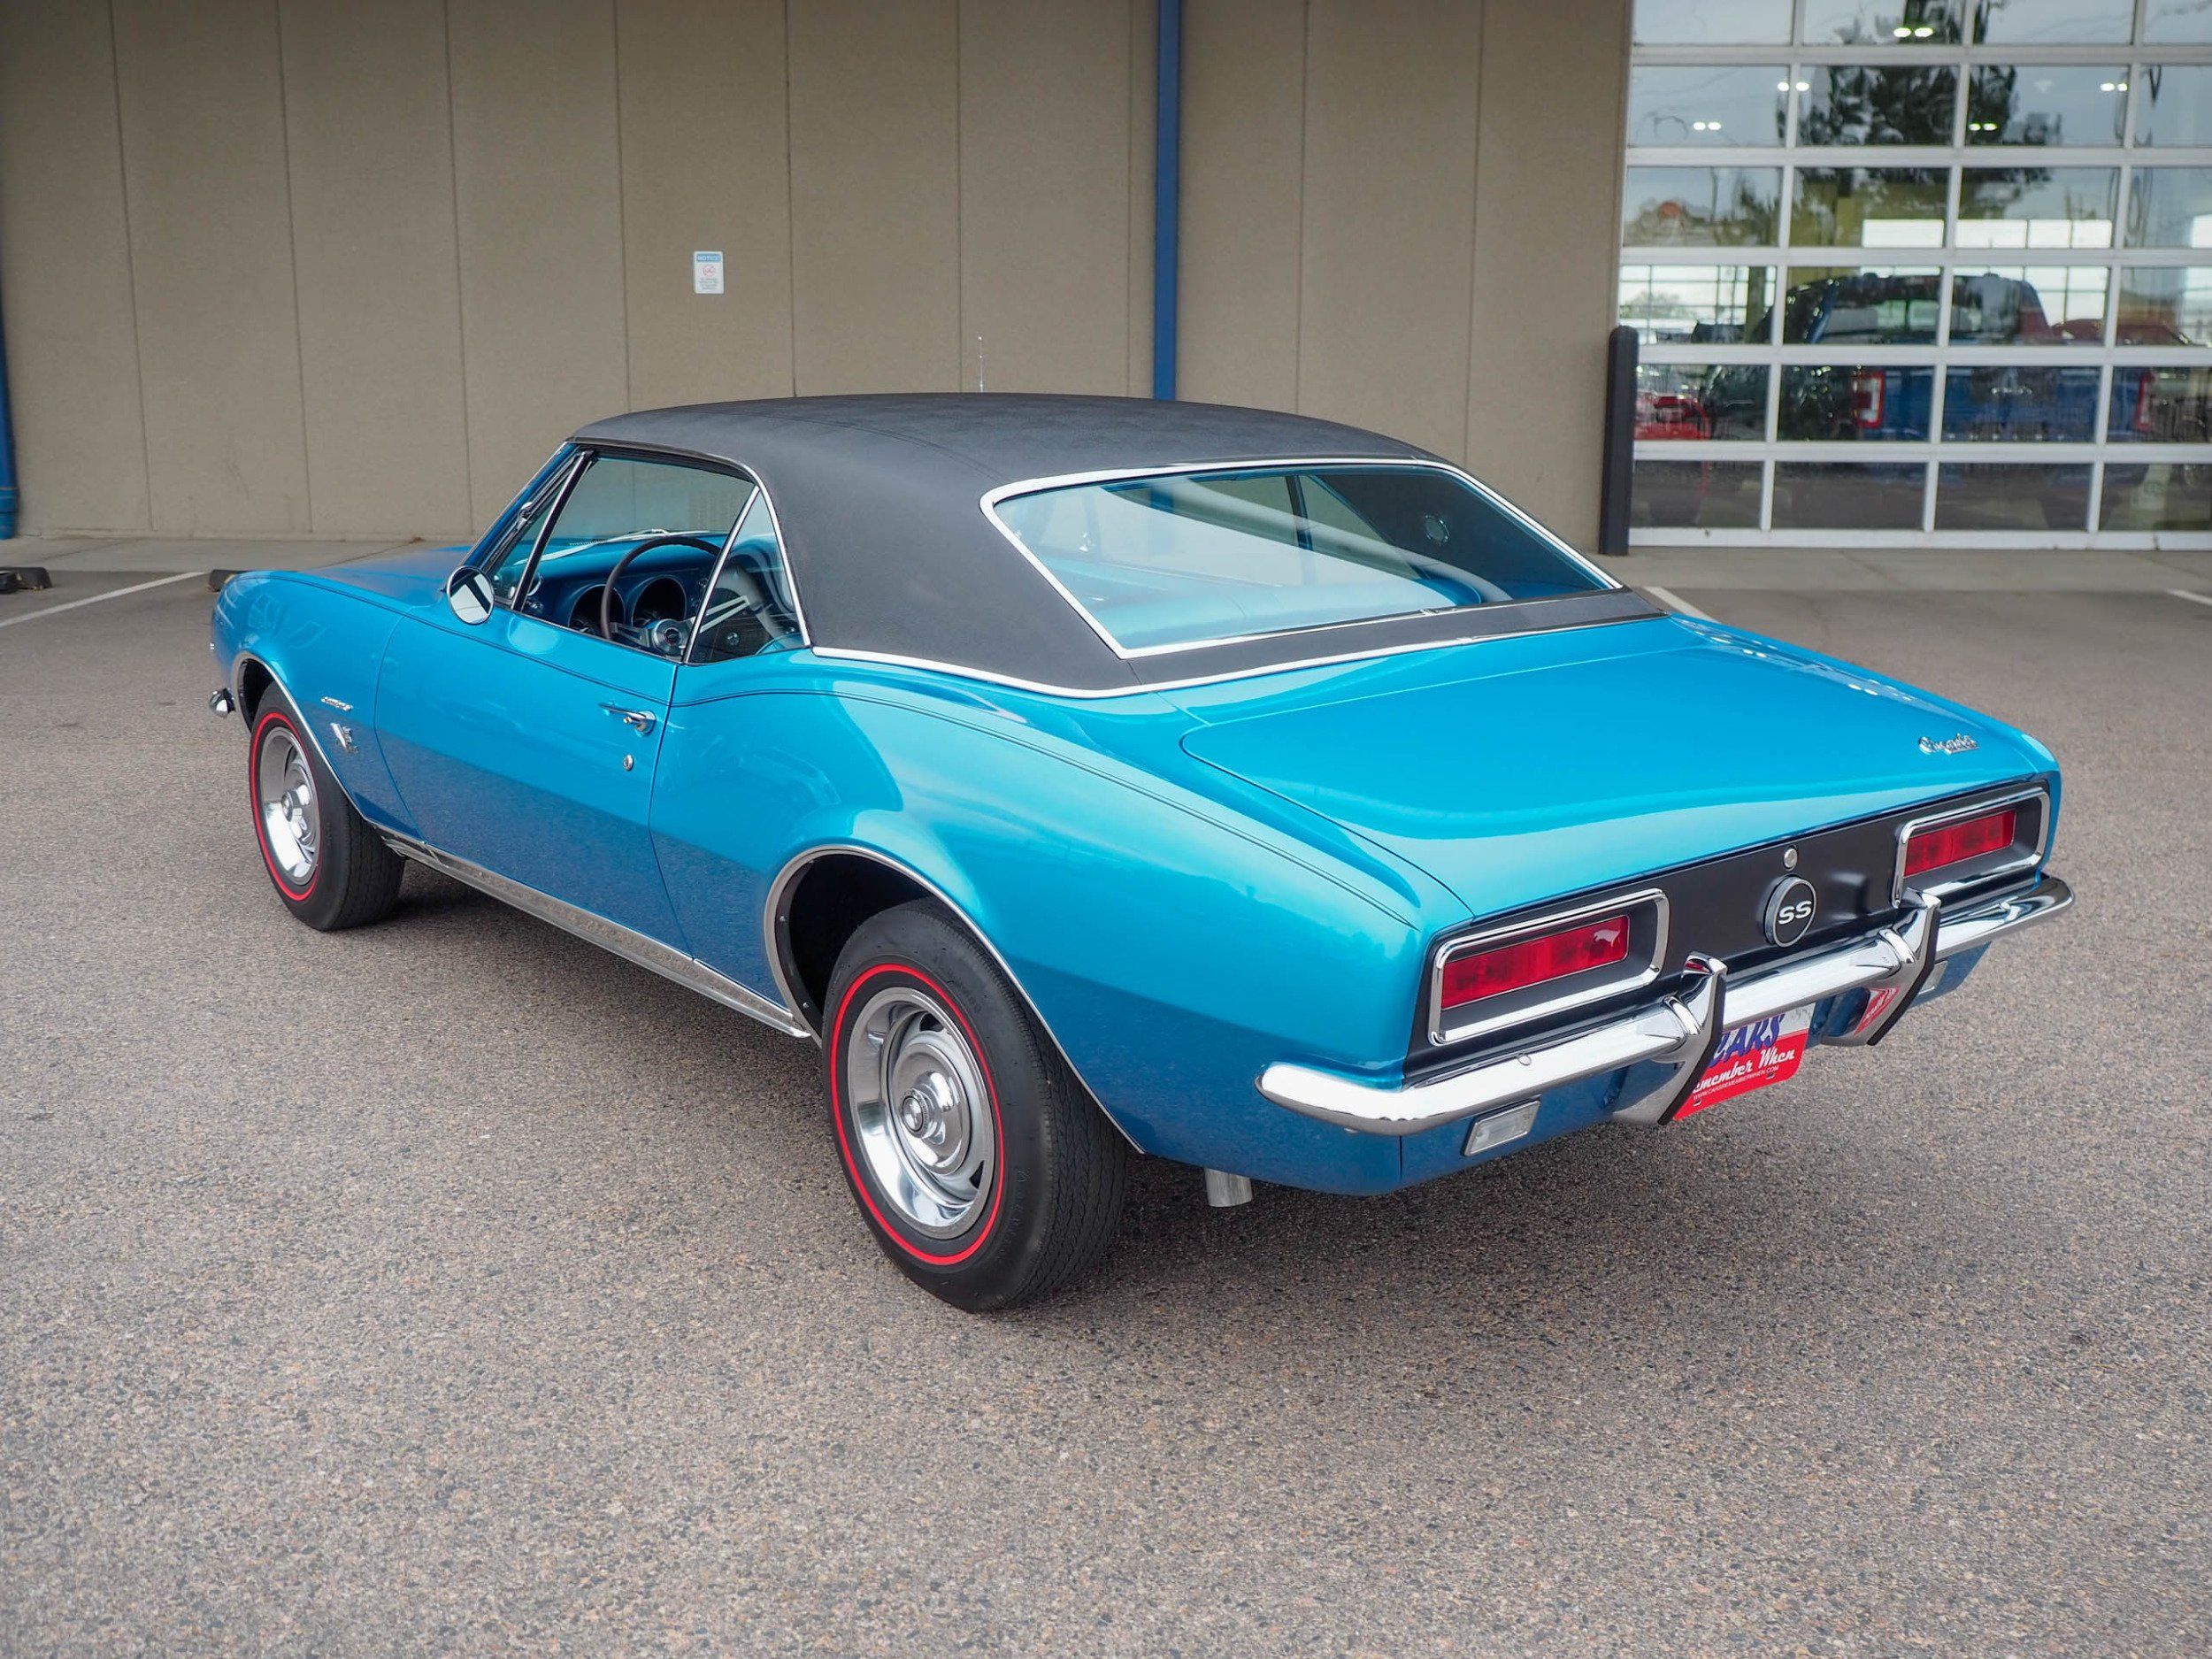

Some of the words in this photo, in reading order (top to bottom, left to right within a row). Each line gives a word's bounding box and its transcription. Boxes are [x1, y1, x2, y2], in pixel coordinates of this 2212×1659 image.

[1778, 900, 1812, 925] SS
[1693, 1060, 1753, 1094] emember
[1759, 1047, 1795, 1069] When
